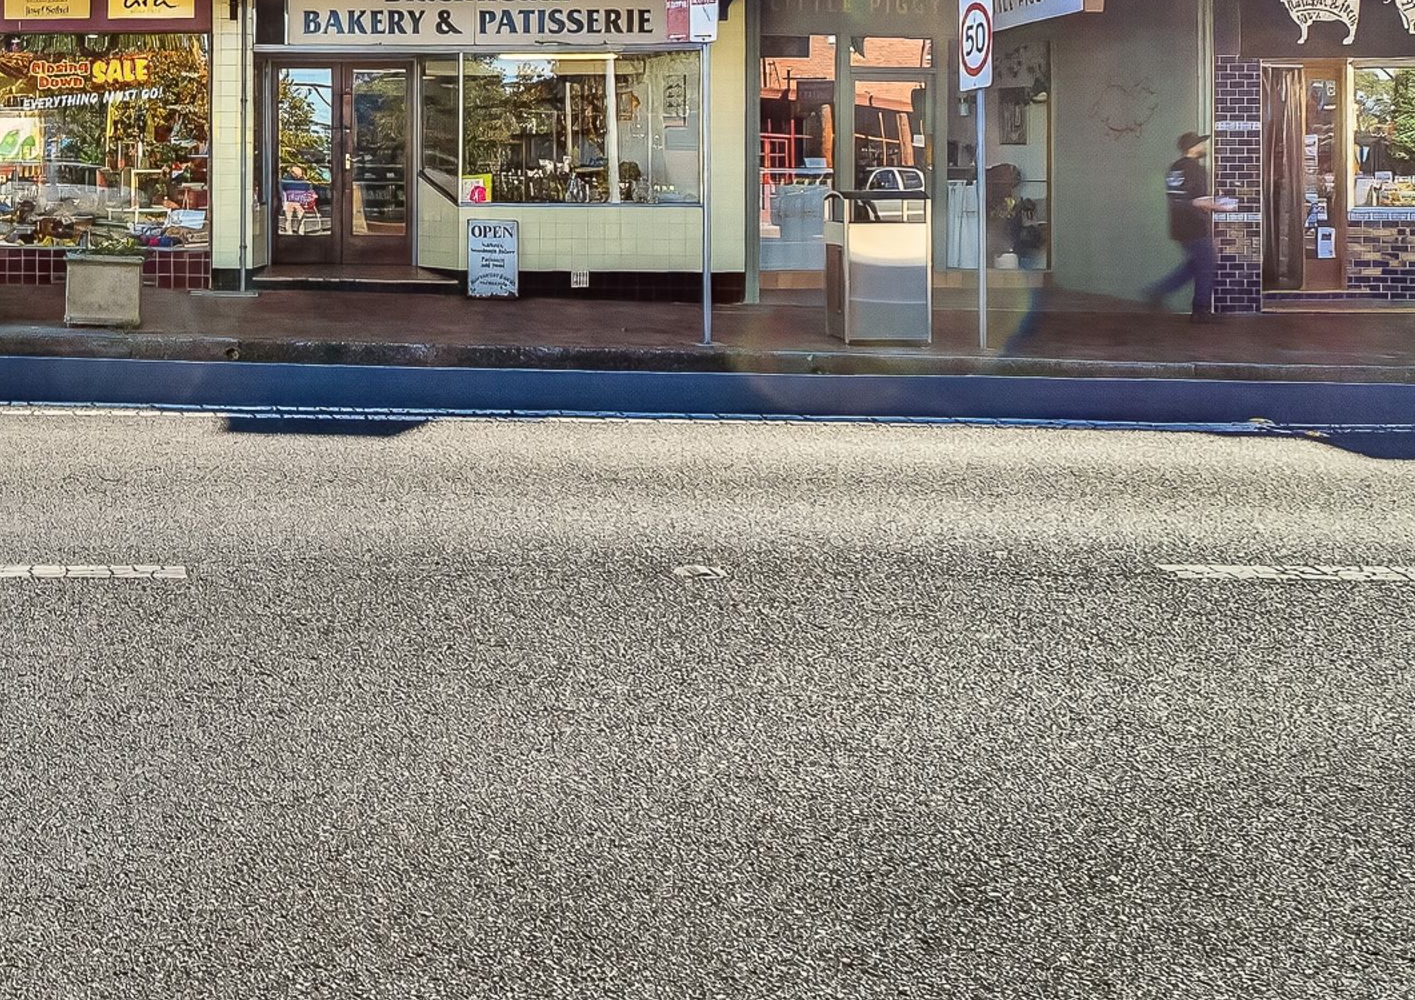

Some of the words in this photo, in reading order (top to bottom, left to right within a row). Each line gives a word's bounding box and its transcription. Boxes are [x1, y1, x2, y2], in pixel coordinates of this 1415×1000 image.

[303, 10, 425, 34] BAKERY
[435, 9, 463, 35] &
[479, 9, 654, 34] PATISSERIE
[965, 22, 986, 56] 50
[30, 60, 89, 75] Closing
[92, 58, 149, 84] SALE
[38, 76, 84, 90] Down
[22, 92, 99, 110] EVERYTHING
[104, 90, 136, 104] MUST
[470, 225, 514, 238] OPEN
